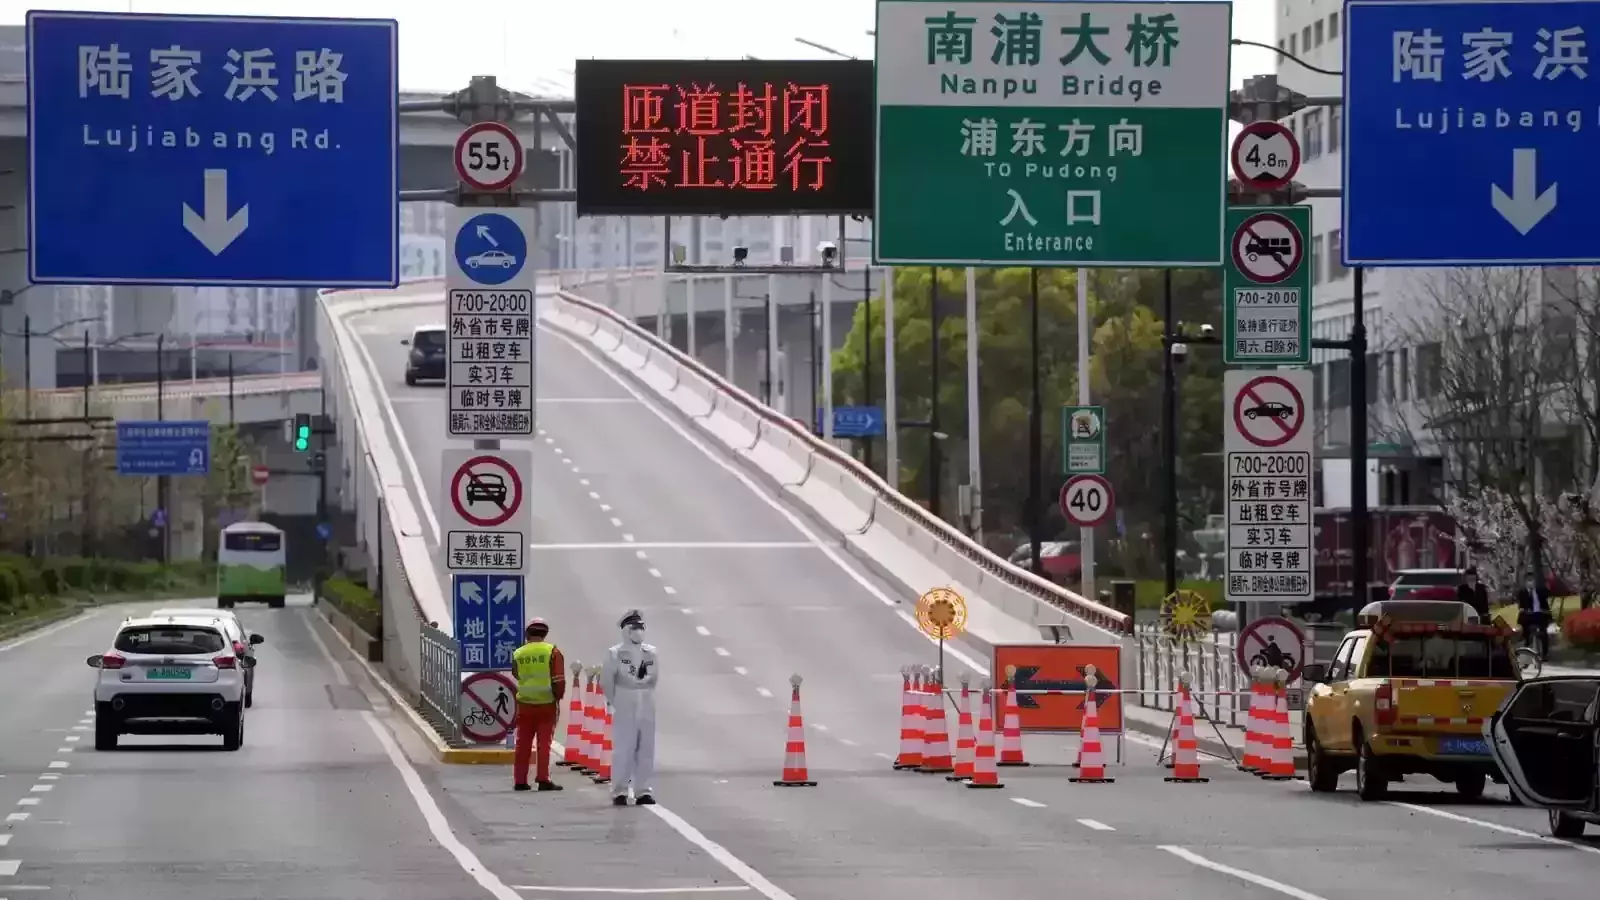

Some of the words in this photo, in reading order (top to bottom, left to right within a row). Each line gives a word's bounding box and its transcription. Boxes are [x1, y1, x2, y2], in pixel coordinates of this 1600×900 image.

[924, 11, 1180, 67] 南浦大桥
[1393, 26, 1588, 83] 陆家浜
[78, 43, 348, 103] 陆家浜路
[941, 74, 1038, 98] Nanpu
[1061, 75, 1163, 101] Bridge
[622, 81, 830, 136] 匝道封闭
[1396, 107, 1582, 134] Lujiabang
[83, 124, 275, 154] Lujiabang
[291, 128, 341, 149] Rd.
[960, 118, 1143, 157] 浦东方向
[468, 142, 510, 171] 55t
[620, 136, 832, 191] 禁止通行
[1245, 144, 1288, 168] 4.8m
[984, 163, 1011, 177] TO
[1025, 163, 1118, 182] Pudong
[999, 189, 1101, 226] 入口
[1004, 232, 1093, 251] Enterance
[455, 294, 527, 311] 7:00-20:00
[1237, 291, 1298, 304] 7:00-2000
[453, 317, 530, 336] 外省市号牌
[1238, 319, 1298, 333] 除持通行证外
[461, 341, 522, 360] 出租空车
[1236, 339, 1299, 354] 周六、日除外
[468, 365, 514, 384] 实习车
[460, 389, 522, 408] 临时号牌
[1233, 456, 1304, 473] 7:00-20:00
[1231, 480, 1308, 497] 外省市号牌
[1070, 487, 1101, 512] 40
[1240, 504, 1301, 521] 出租空车
[465, 534, 505, 549] 教练车
[1247, 527, 1292, 545] 实习车
[453, 552, 517, 566] 专项作业车
[1239, 551, 1301, 569] 临时号牌
[463, 616, 486, 665] 地面
[494, 614, 517, 664] 大桥
